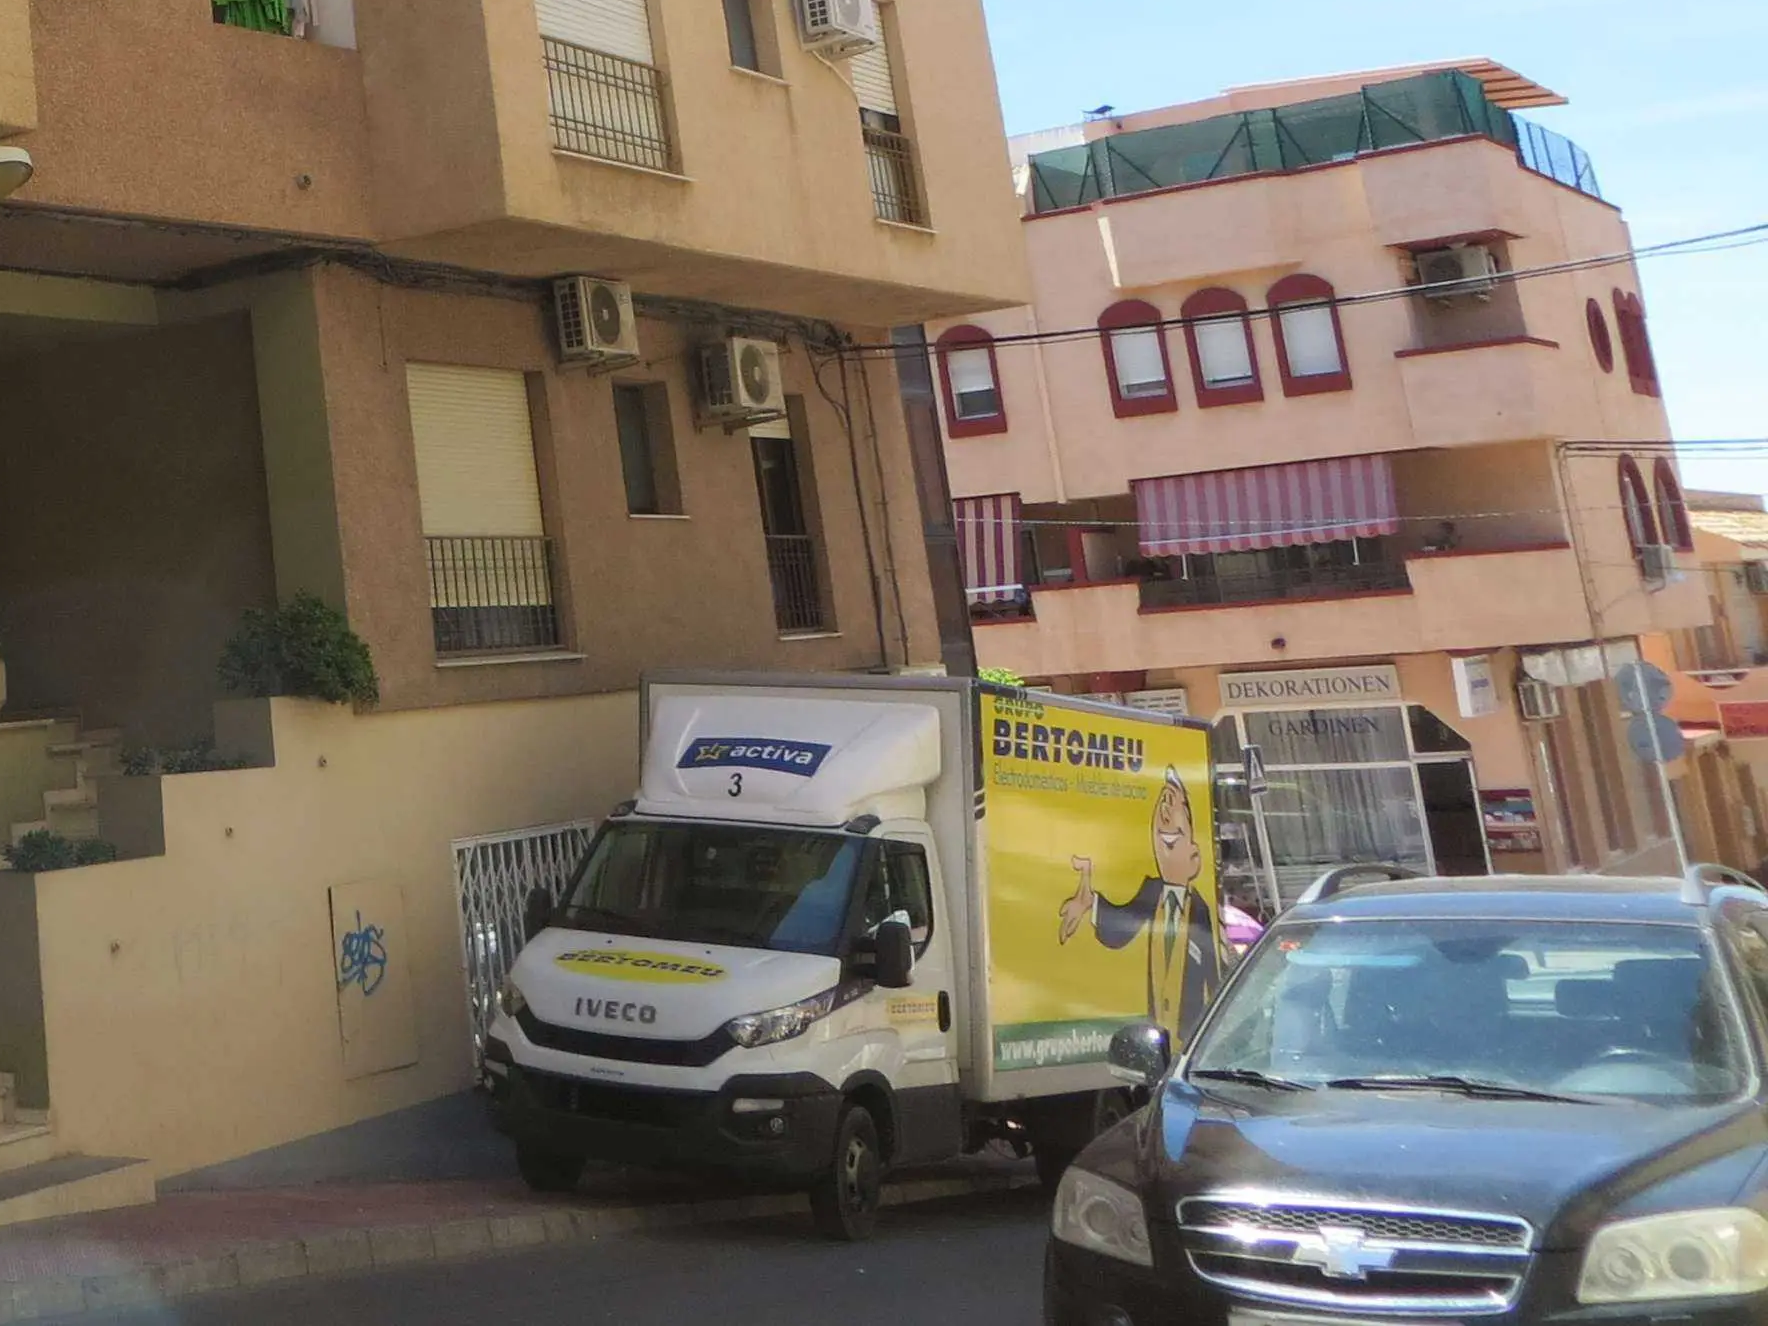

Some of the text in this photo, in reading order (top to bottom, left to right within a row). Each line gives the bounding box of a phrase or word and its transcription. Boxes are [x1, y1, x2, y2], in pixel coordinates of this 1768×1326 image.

[1227, 675, 1390, 699] DEKORATIONEN
[994, 696, 1045, 720] GRUPO
[1268, 716, 1380, 736] GARDINEN
[730, 745, 814, 765] activa
[993, 719, 1144, 773] BERTOMEU
[728, 773, 743, 797] 3
[556, 953, 725, 976] BERTOMEU
[575, 997, 657, 1024] IVECO
[1000, 1028, 1114, 1065] www.grupobertom
